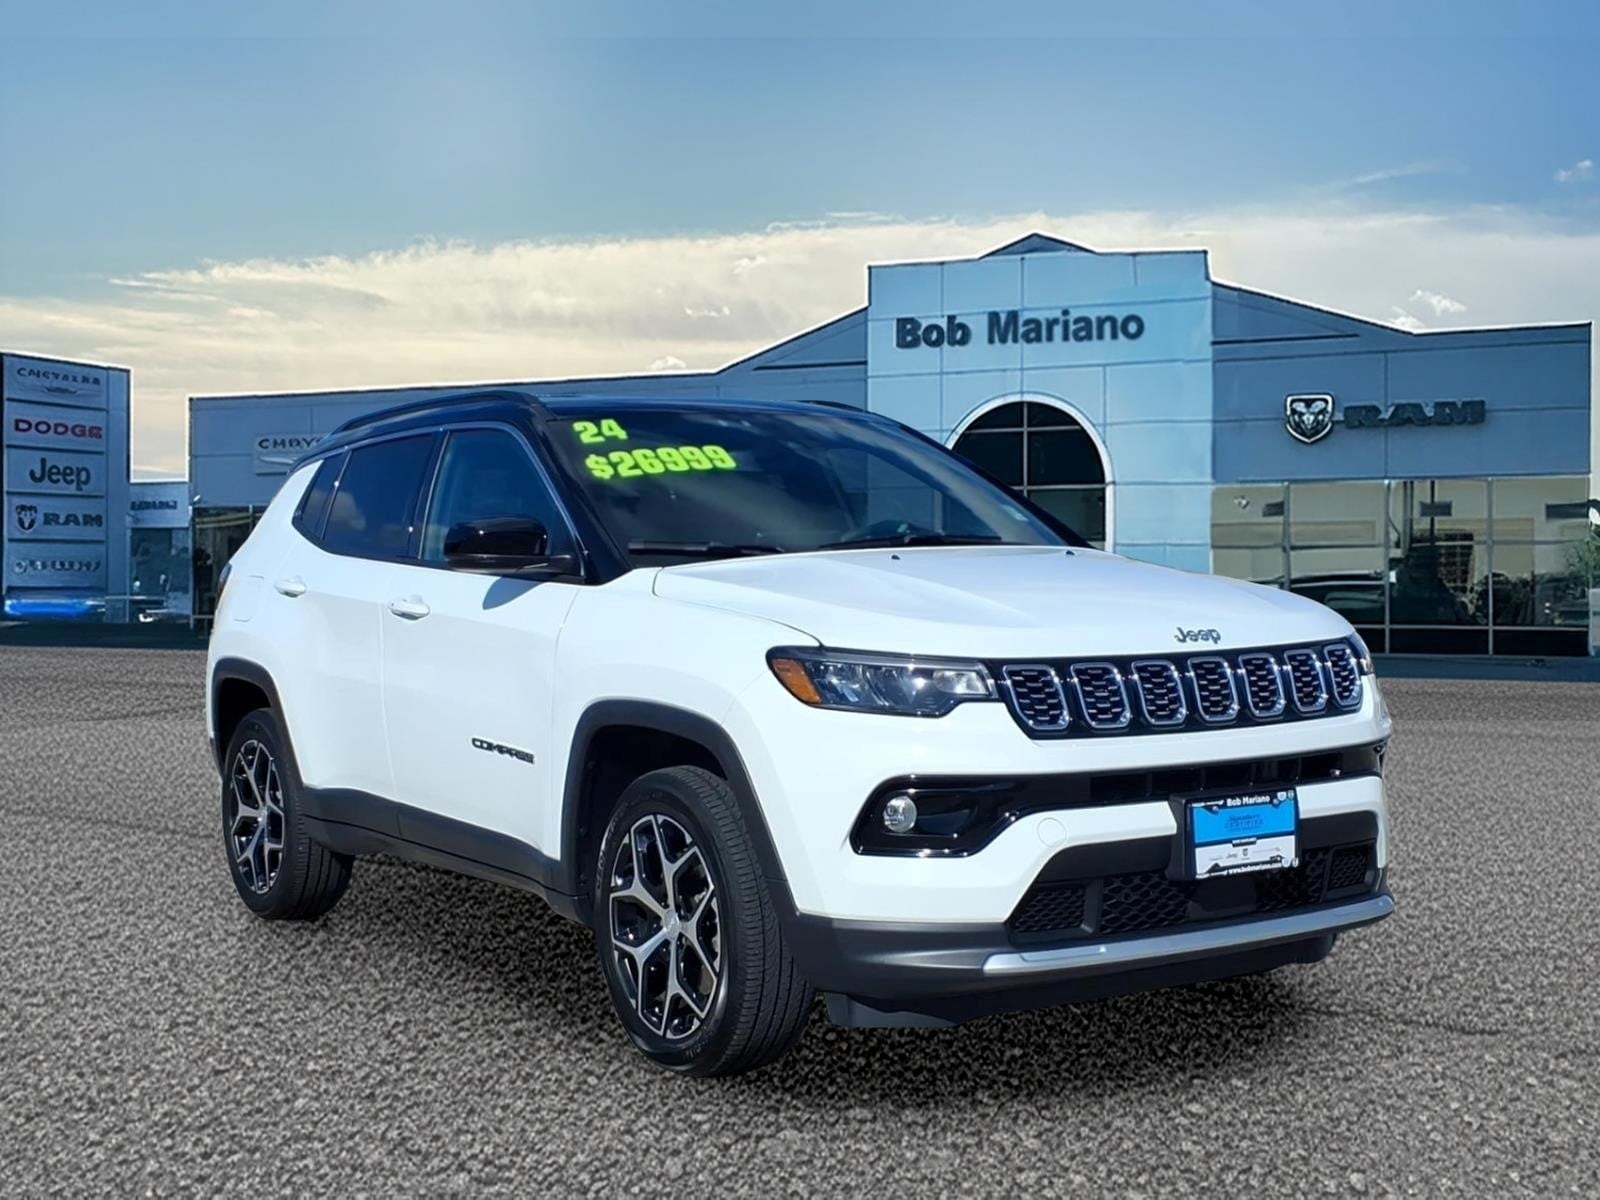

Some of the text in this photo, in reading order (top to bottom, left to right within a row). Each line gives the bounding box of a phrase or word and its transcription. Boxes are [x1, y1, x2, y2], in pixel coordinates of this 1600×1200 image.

[895, 309, 1145, 349] Bob Mariano
[1343, 400, 1486, 429] RAM
[14, 418, 103, 439] DODGE
[572, 418, 628, 444] 24
[29, 457, 91, 491] Jeep
[585, 445, 737, 480] $26999
[43, 512, 103, 528] RAM
[1173, 626, 1222, 645] Jeep
[1226, 794, 1271, 807] Bob Mariano
